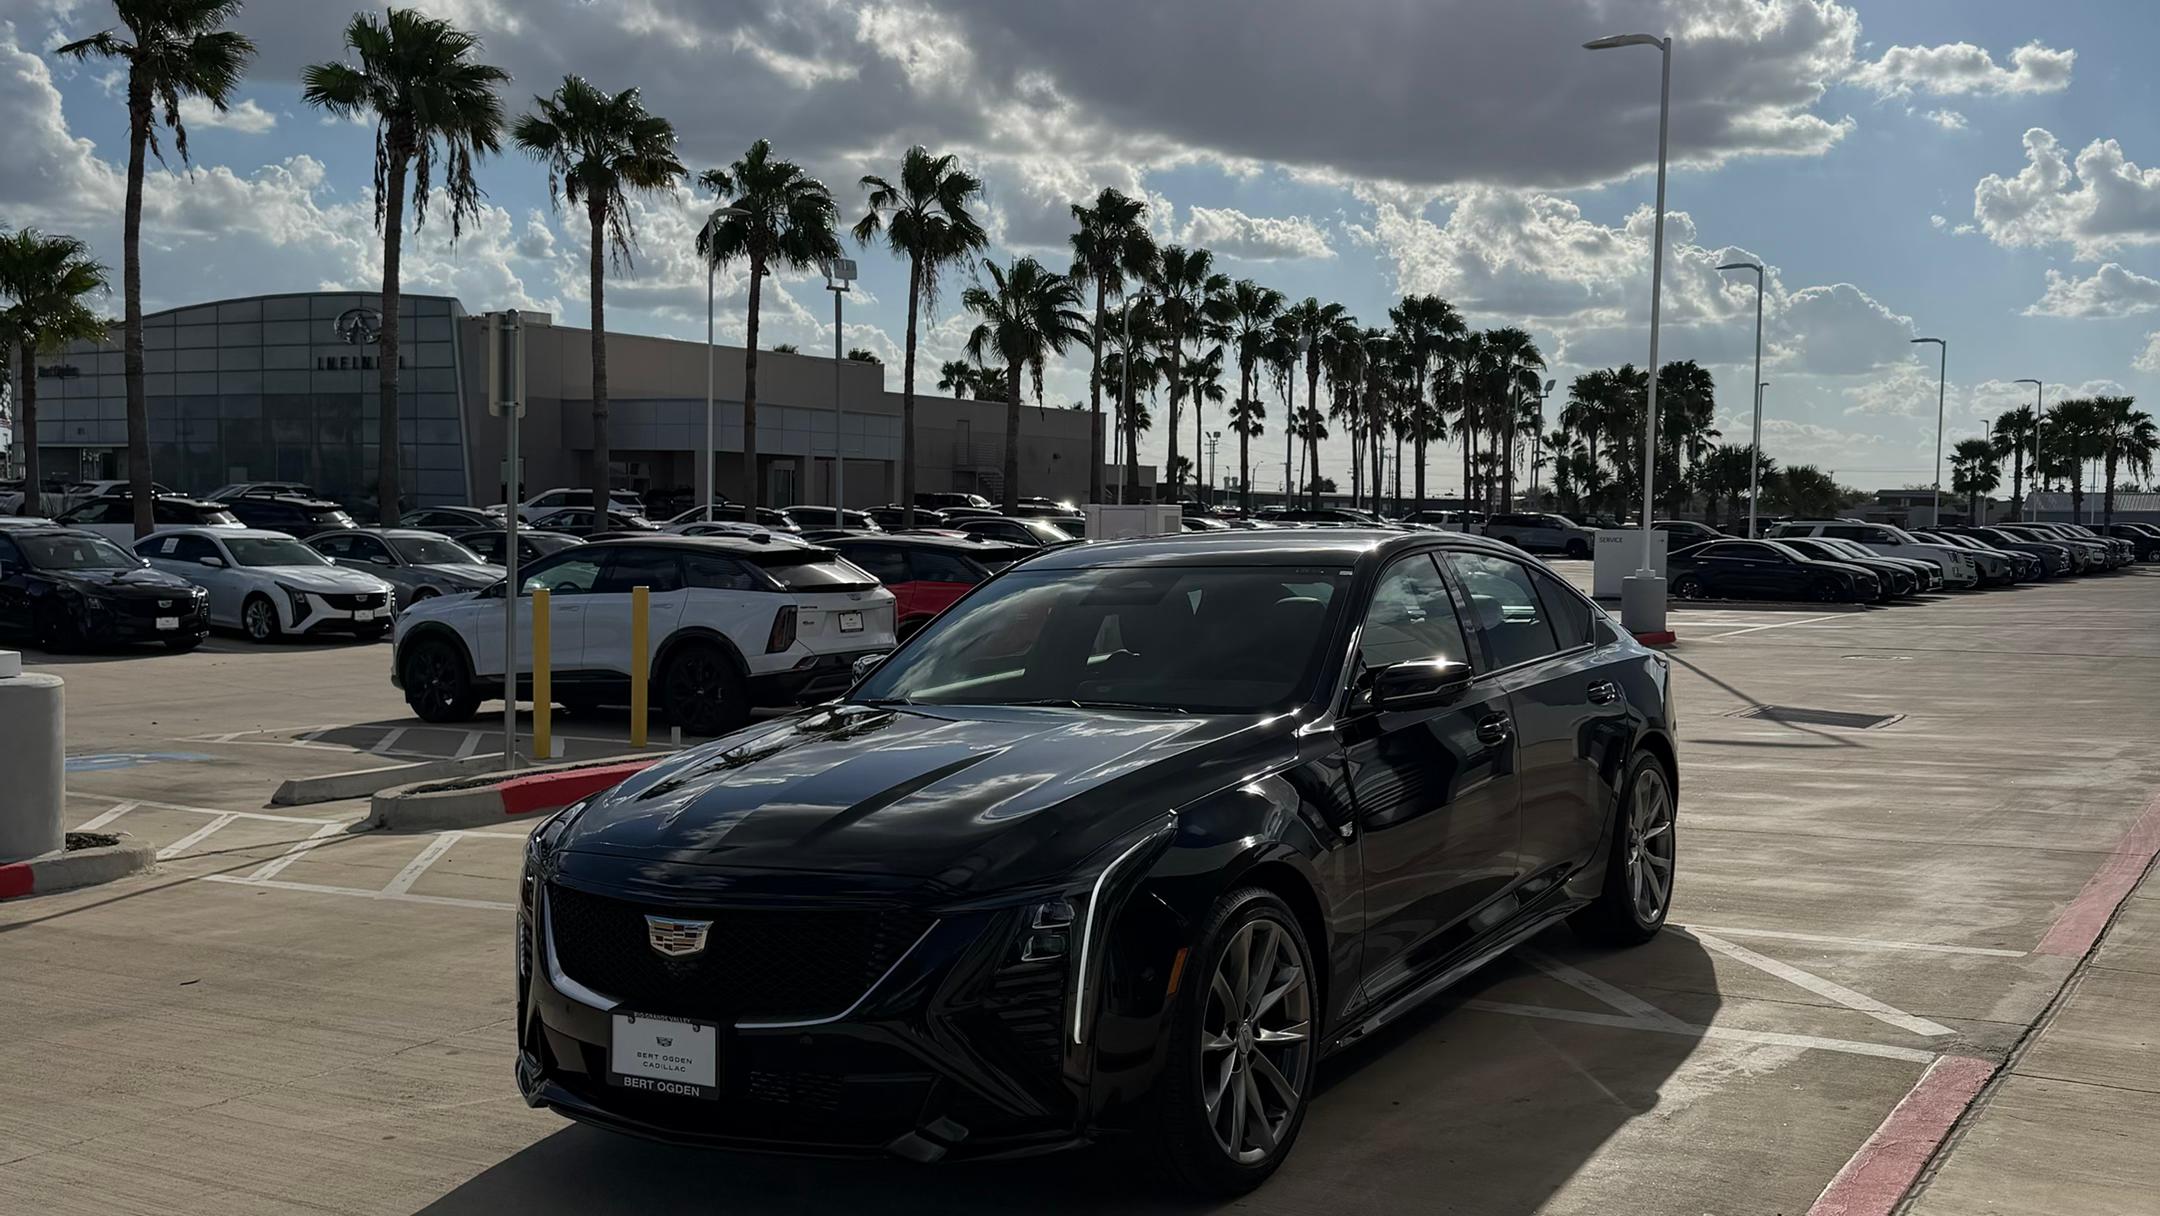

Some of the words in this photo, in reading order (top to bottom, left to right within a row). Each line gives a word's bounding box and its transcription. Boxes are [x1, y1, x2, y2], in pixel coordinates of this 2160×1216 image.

[318, 356, 405, 370] INFINII
[637, 1051, 659, 1060] BERT
[662, 1055, 693, 1064] OGDEN
[642, 1061, 686, 1072] CADILLAC
[624, 1076, 654, 1090] BERT
[657, 1081, 700, 1096] OGDEN
